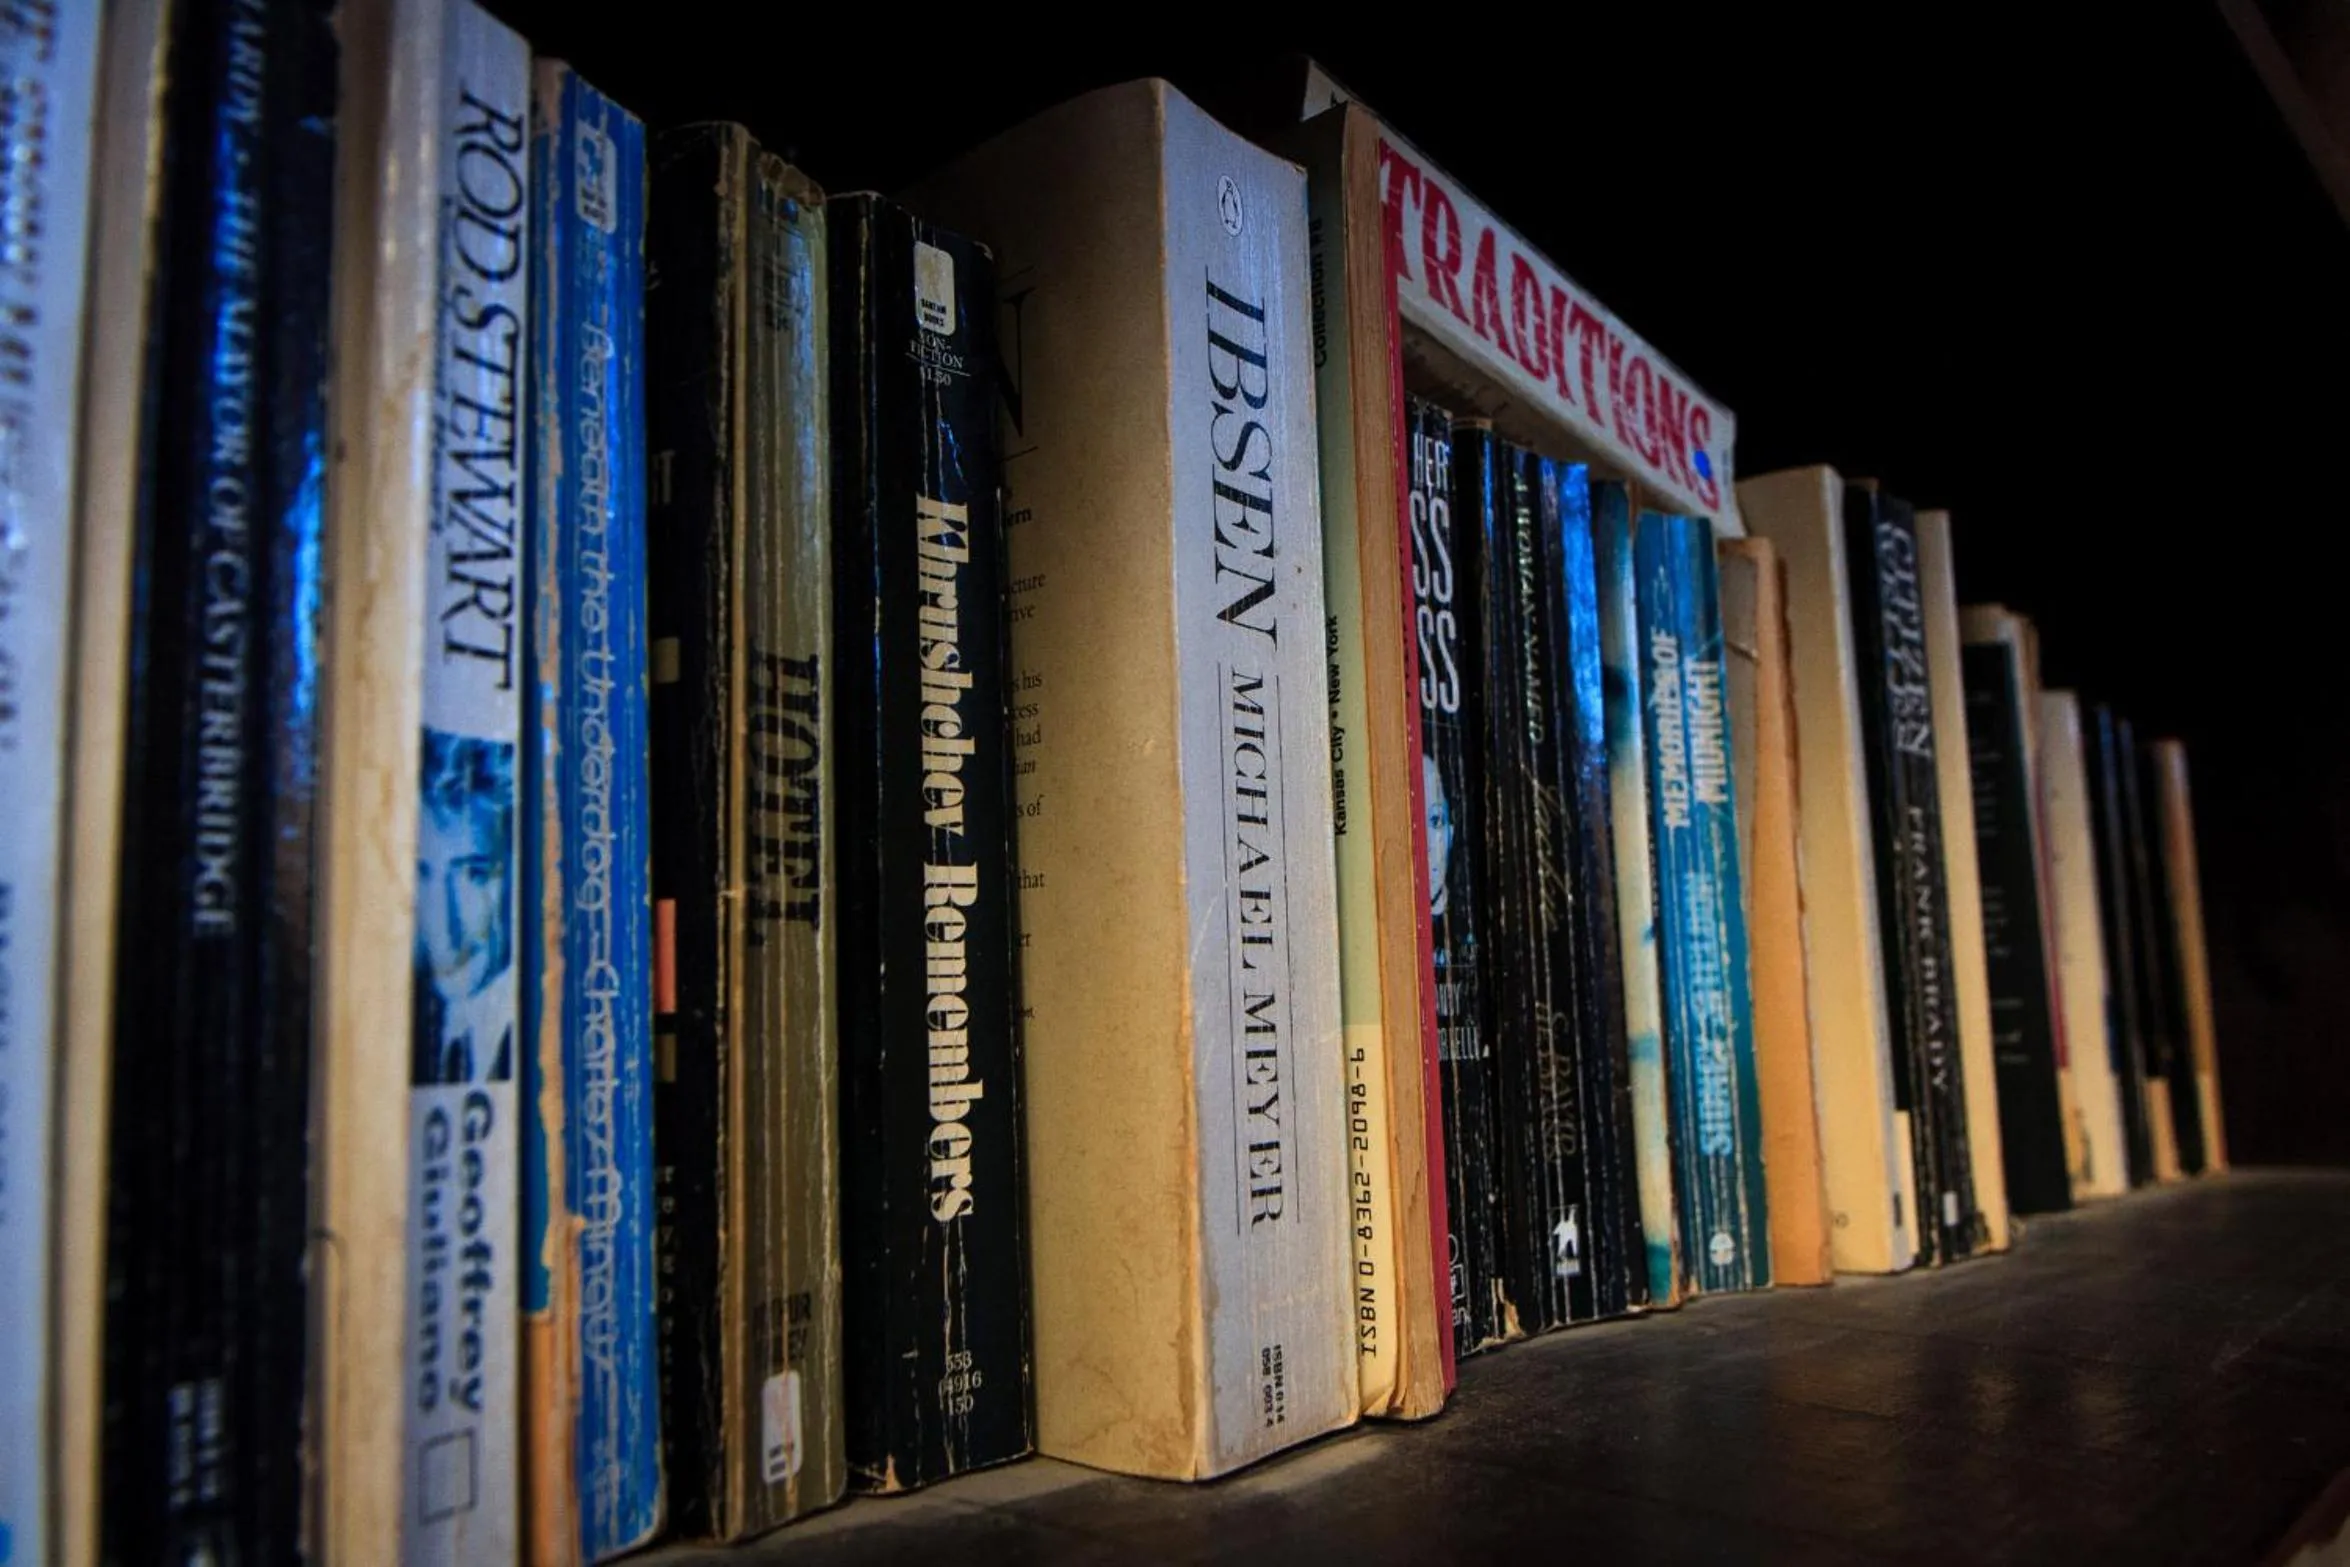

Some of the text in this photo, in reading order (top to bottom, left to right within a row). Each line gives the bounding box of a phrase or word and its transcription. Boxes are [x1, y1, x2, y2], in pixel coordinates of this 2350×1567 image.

[208, 287, 258, 470] MAYOR
[441, 88, 524, 691] ROD STEWART
[578, 320, 618, 535] Beneath
[1379, 137, 1720, 512] TRADITIONS
[207, 476, 250, 544] OF
[579, 547, 618, 634] the
[916, 491, 976, 837] Khrushchev
[191, 550, 251, 938] CASTERBRIDGE
[572, 649, 620, 912] Underdog
[748, 638, 821, 948] HOTEL
[1204, 265, 1285, 1236] IBSEN MICHAEL MEYER
[1325, 615, 1348, 836] Kansas City New York
[1650, 625, 1692, 830] MEMORIES OF
[1683, 654, 1730, 805] MIDNIGHT
[922, 860, 983, 1223] Remembers
[418, 1106, 453, 1414] Giuliano
[450, 1089, 496, 1414] Geoffrey
[1349, 1046, 1377, 1357] ISBN 0-8362-2098-6
